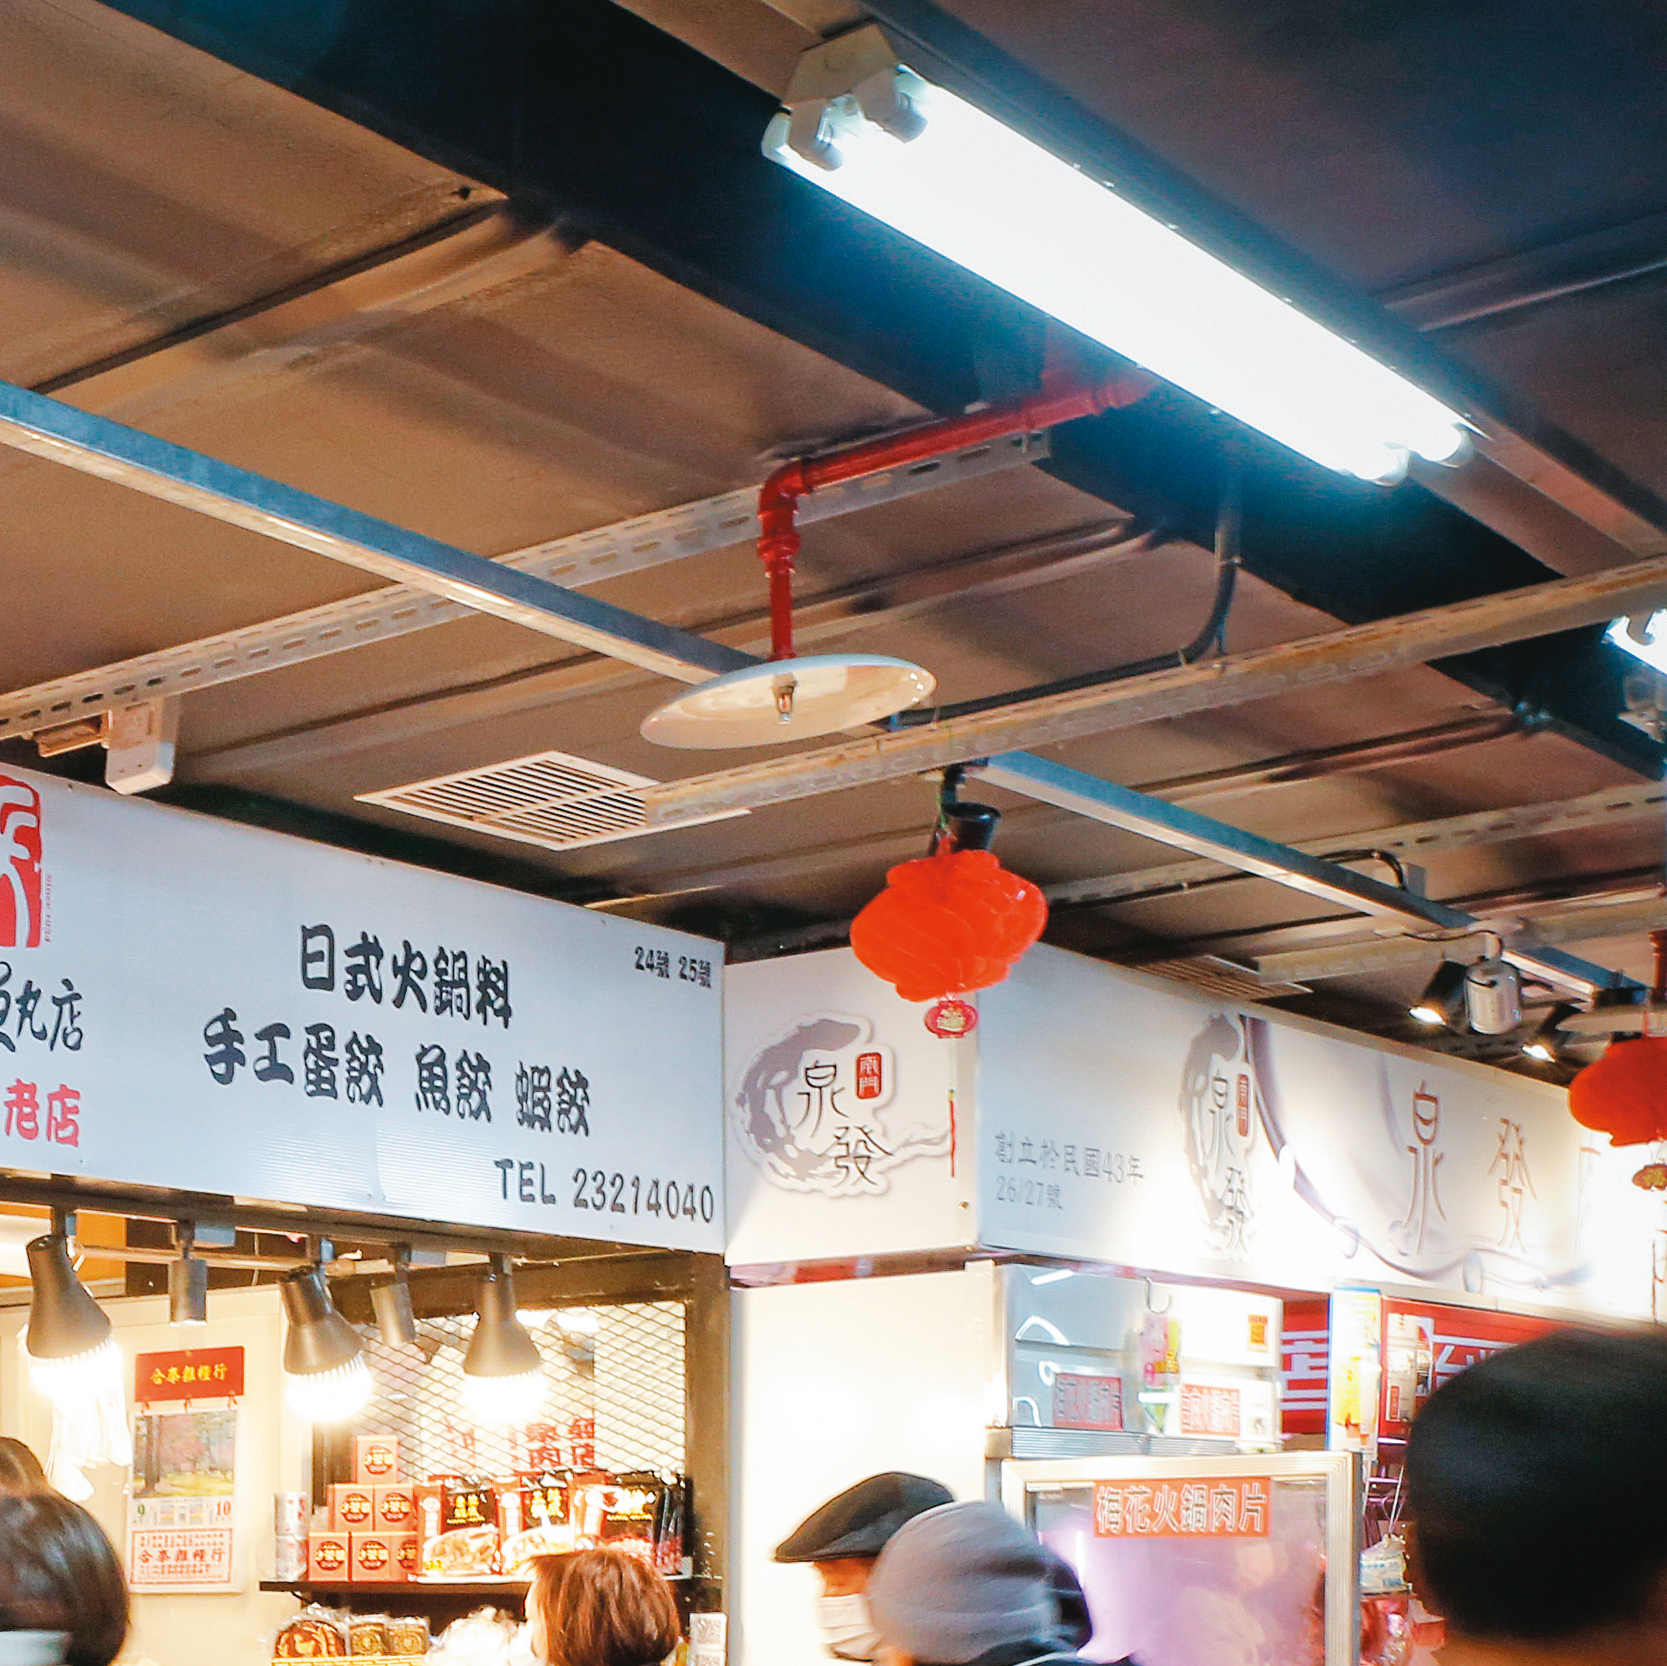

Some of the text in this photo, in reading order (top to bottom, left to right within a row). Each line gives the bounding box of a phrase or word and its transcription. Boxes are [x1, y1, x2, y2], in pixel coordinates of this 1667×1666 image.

[300, 923, 513, 1029] 日式火鍋料
[634, 945, 712, 988] 24號 25號
[203, 1007, 591, 1137] 手工蛋餃 魚餃 蝦餃
[859, 1055, 880, 1096] 南門
[493, 1158, 715, 1224] TEL 23214040
[1096, 1482, 1267, 1536] 梅花火鍋肉片
